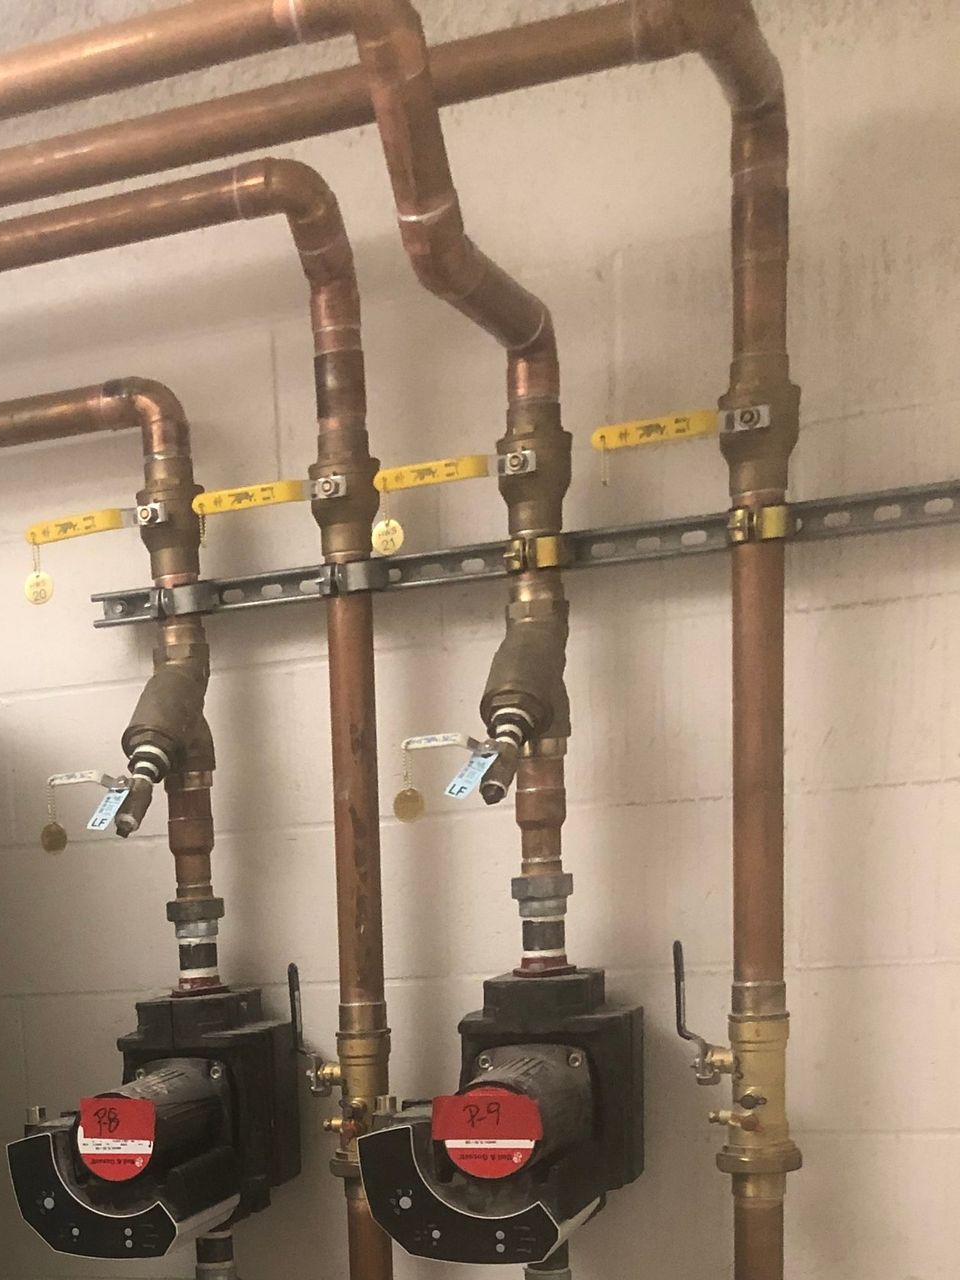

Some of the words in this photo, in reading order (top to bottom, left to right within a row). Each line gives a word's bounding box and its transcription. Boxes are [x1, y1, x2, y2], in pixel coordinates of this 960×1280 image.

[381, 538, 396, 551] 21
[32, 588, 47, 601] 20
[448, 784, 467, 796] LF
[91, 818, 108, 828] LF
[462, 1102, 501, 1128] P-9
